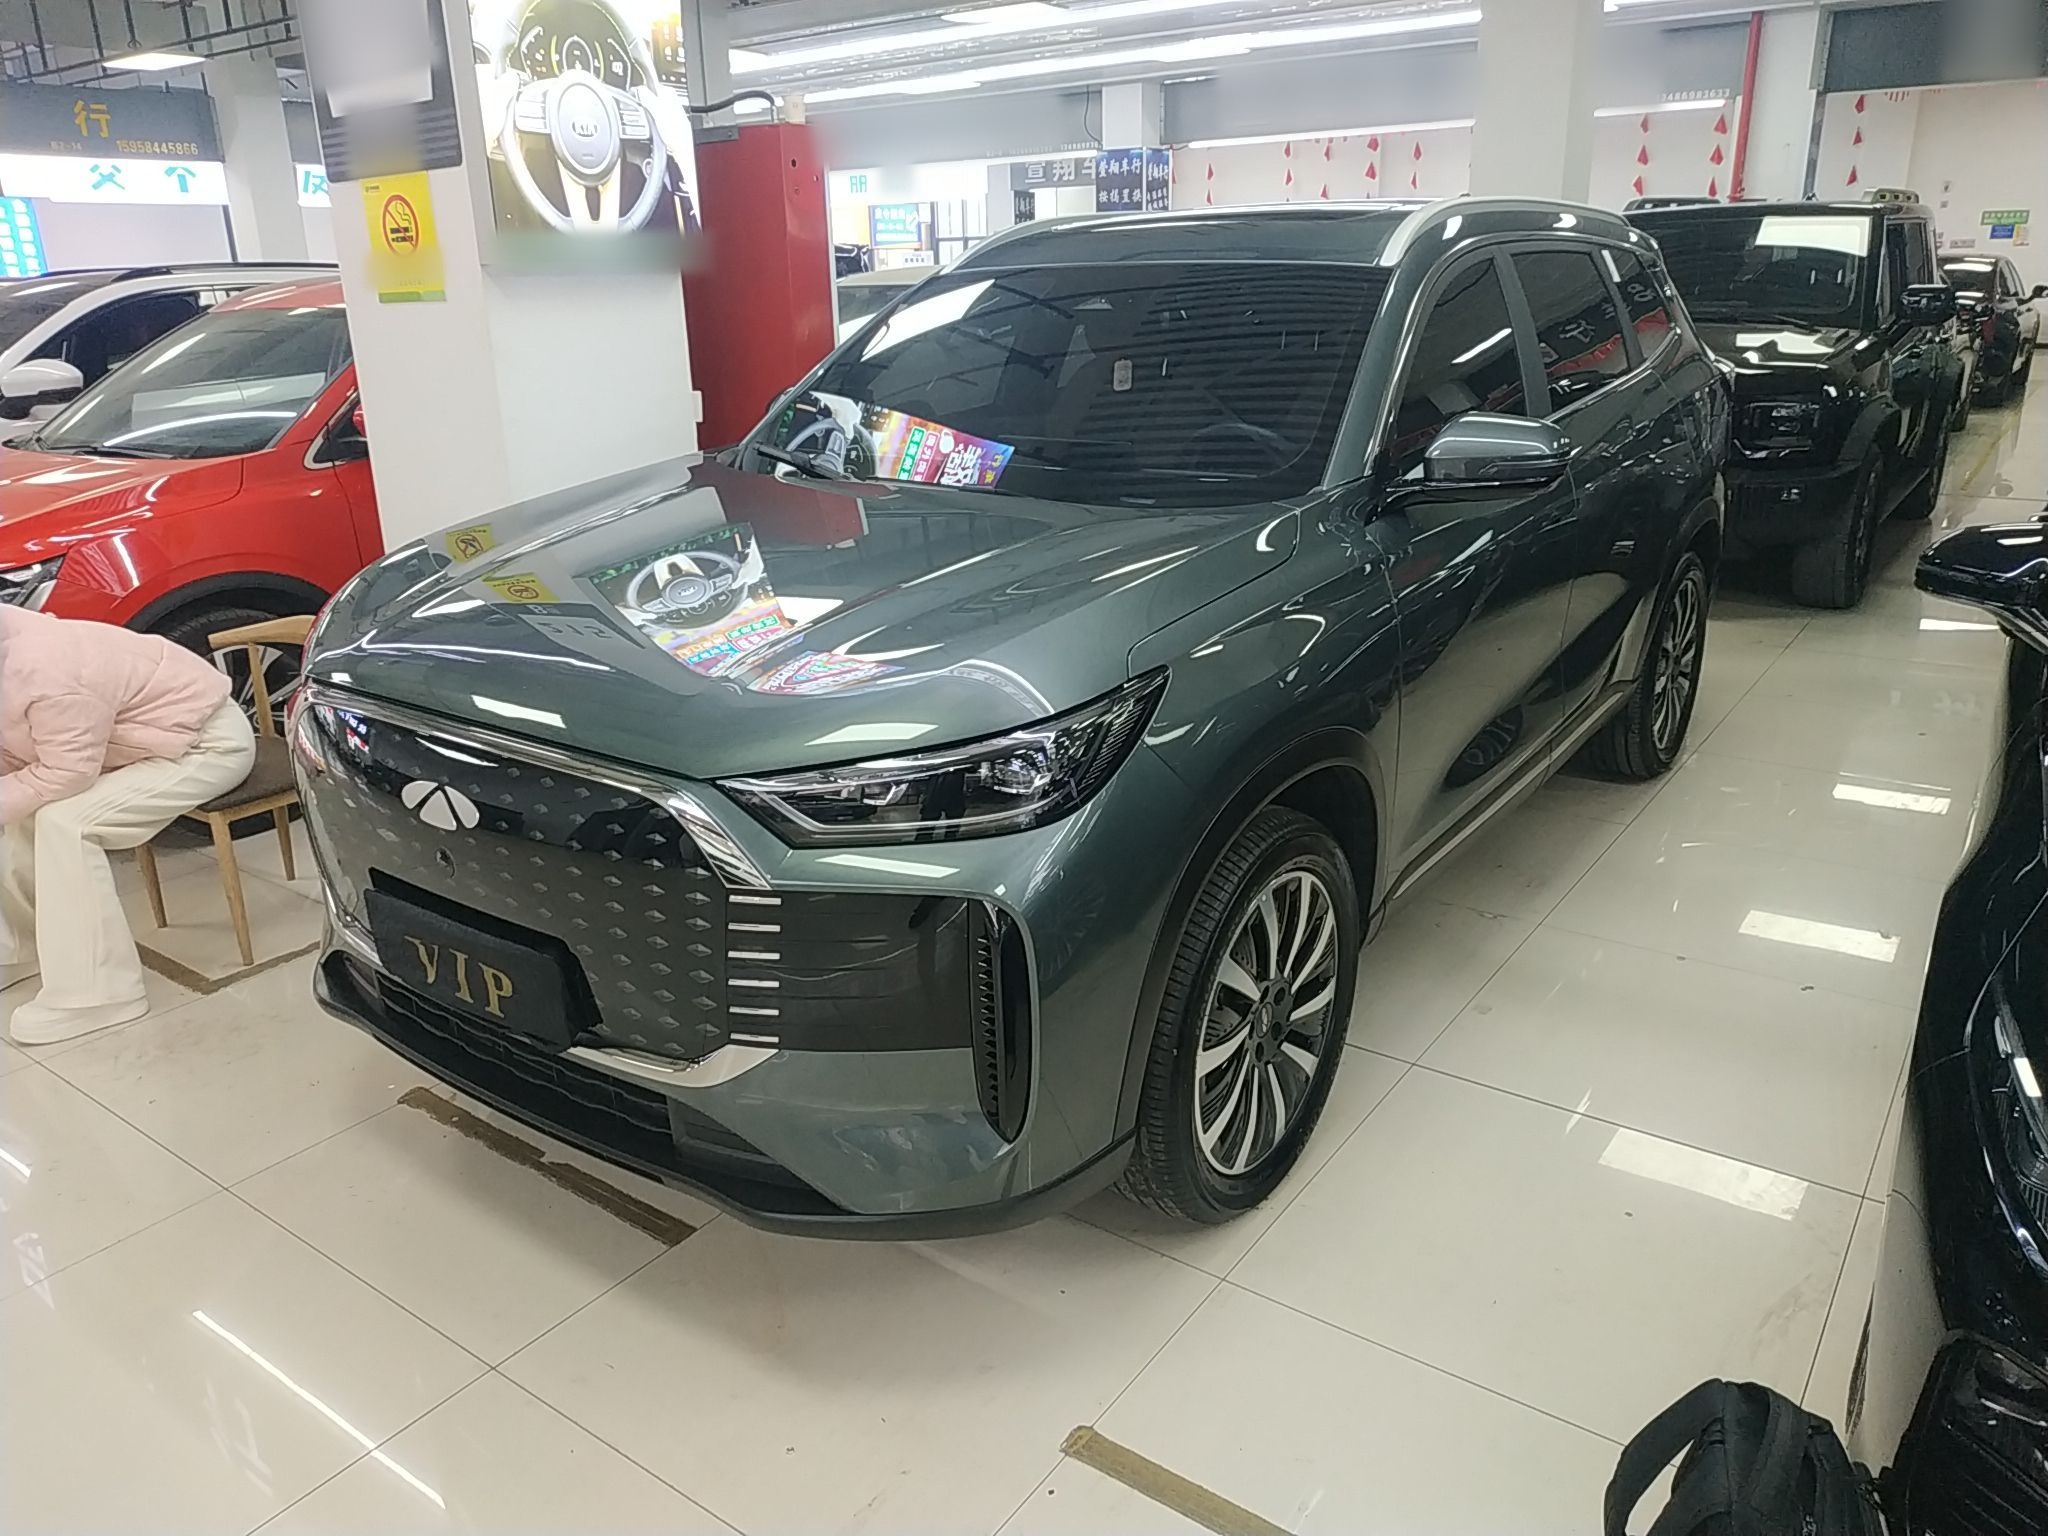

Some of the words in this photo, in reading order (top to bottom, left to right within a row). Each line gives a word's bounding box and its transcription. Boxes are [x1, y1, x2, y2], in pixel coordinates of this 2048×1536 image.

[73, 99, 112, 138] 行
[116, 140, 199, 155] 15958445866
[404, 935, 513, 1019] VIP
